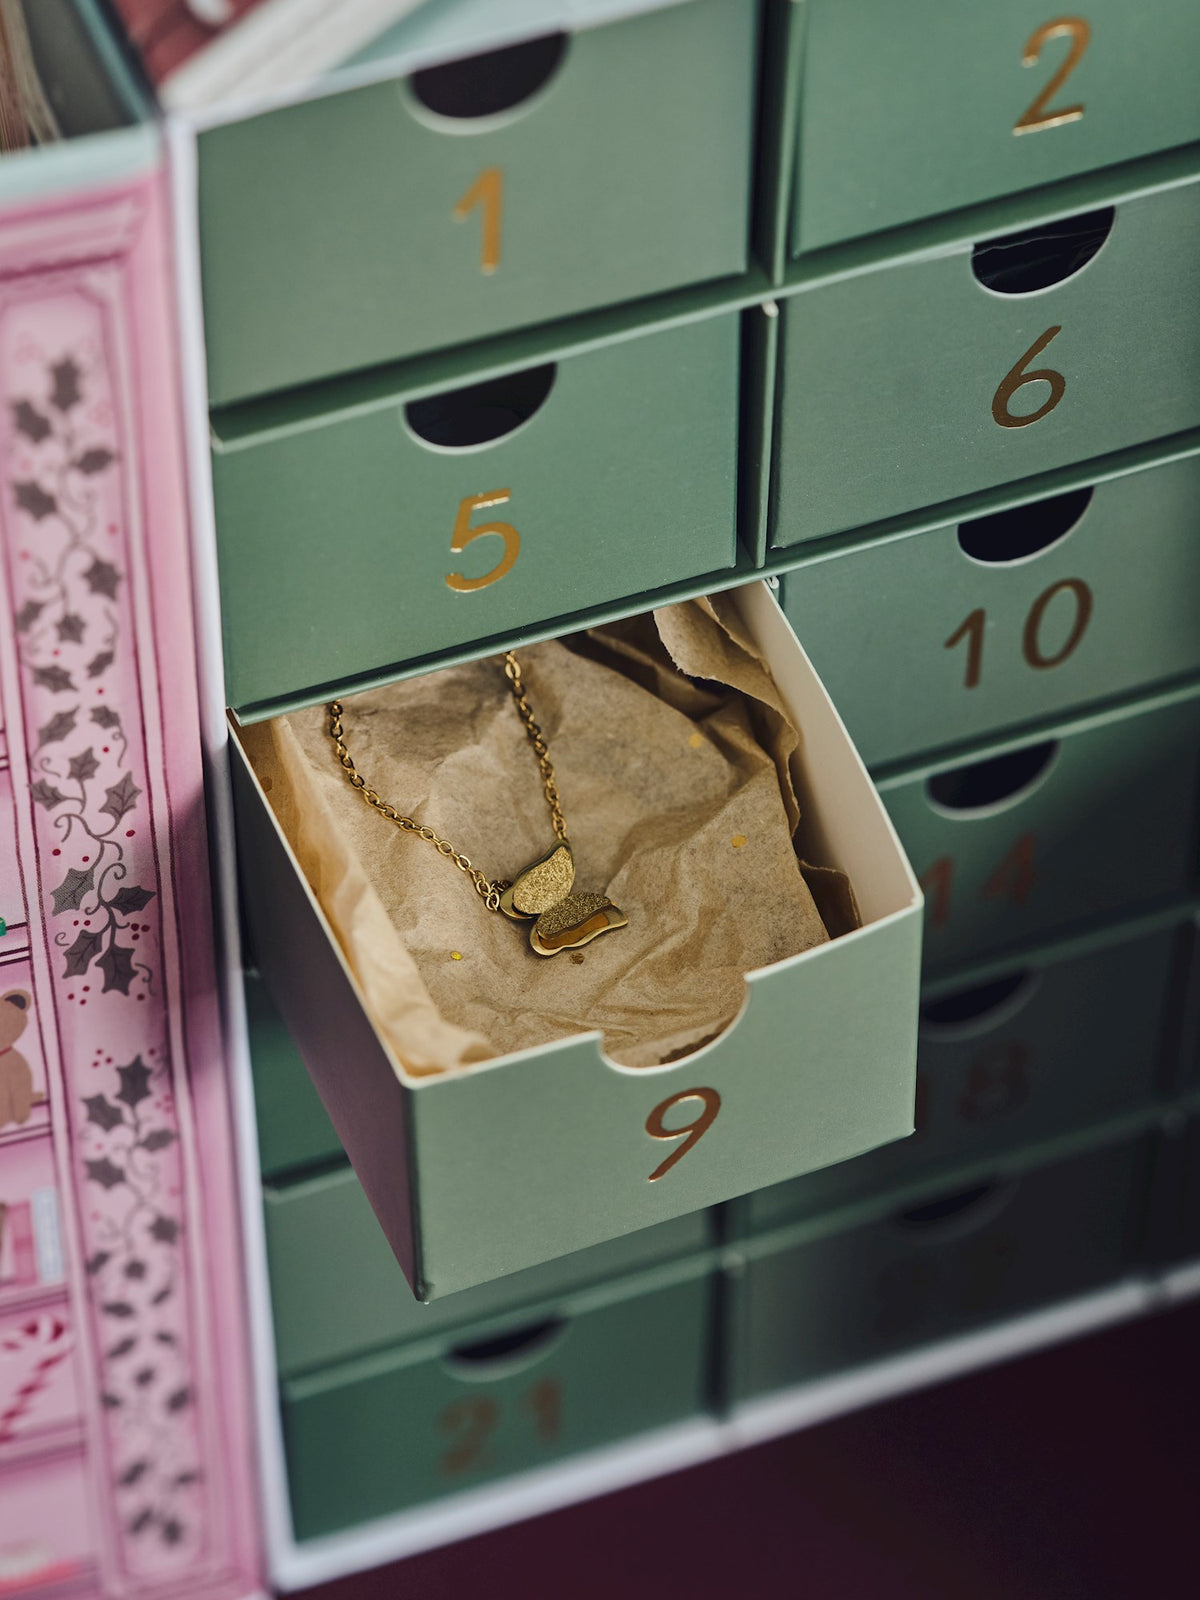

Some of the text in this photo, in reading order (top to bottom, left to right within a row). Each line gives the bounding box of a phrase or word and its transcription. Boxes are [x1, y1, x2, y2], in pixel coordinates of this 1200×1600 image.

[1012, 17, 1091, 137] 2
[452, 167, 504, 277] 1
[991, 326, 1066, 430] 6
[445, 488, 522, 594] 5
[943, 577, 1094, 690] 10
[918, 832, 1040, 928] 14
[645, 1087, 721, 1184] 9
[438, 1378, 564, 1477] 21
